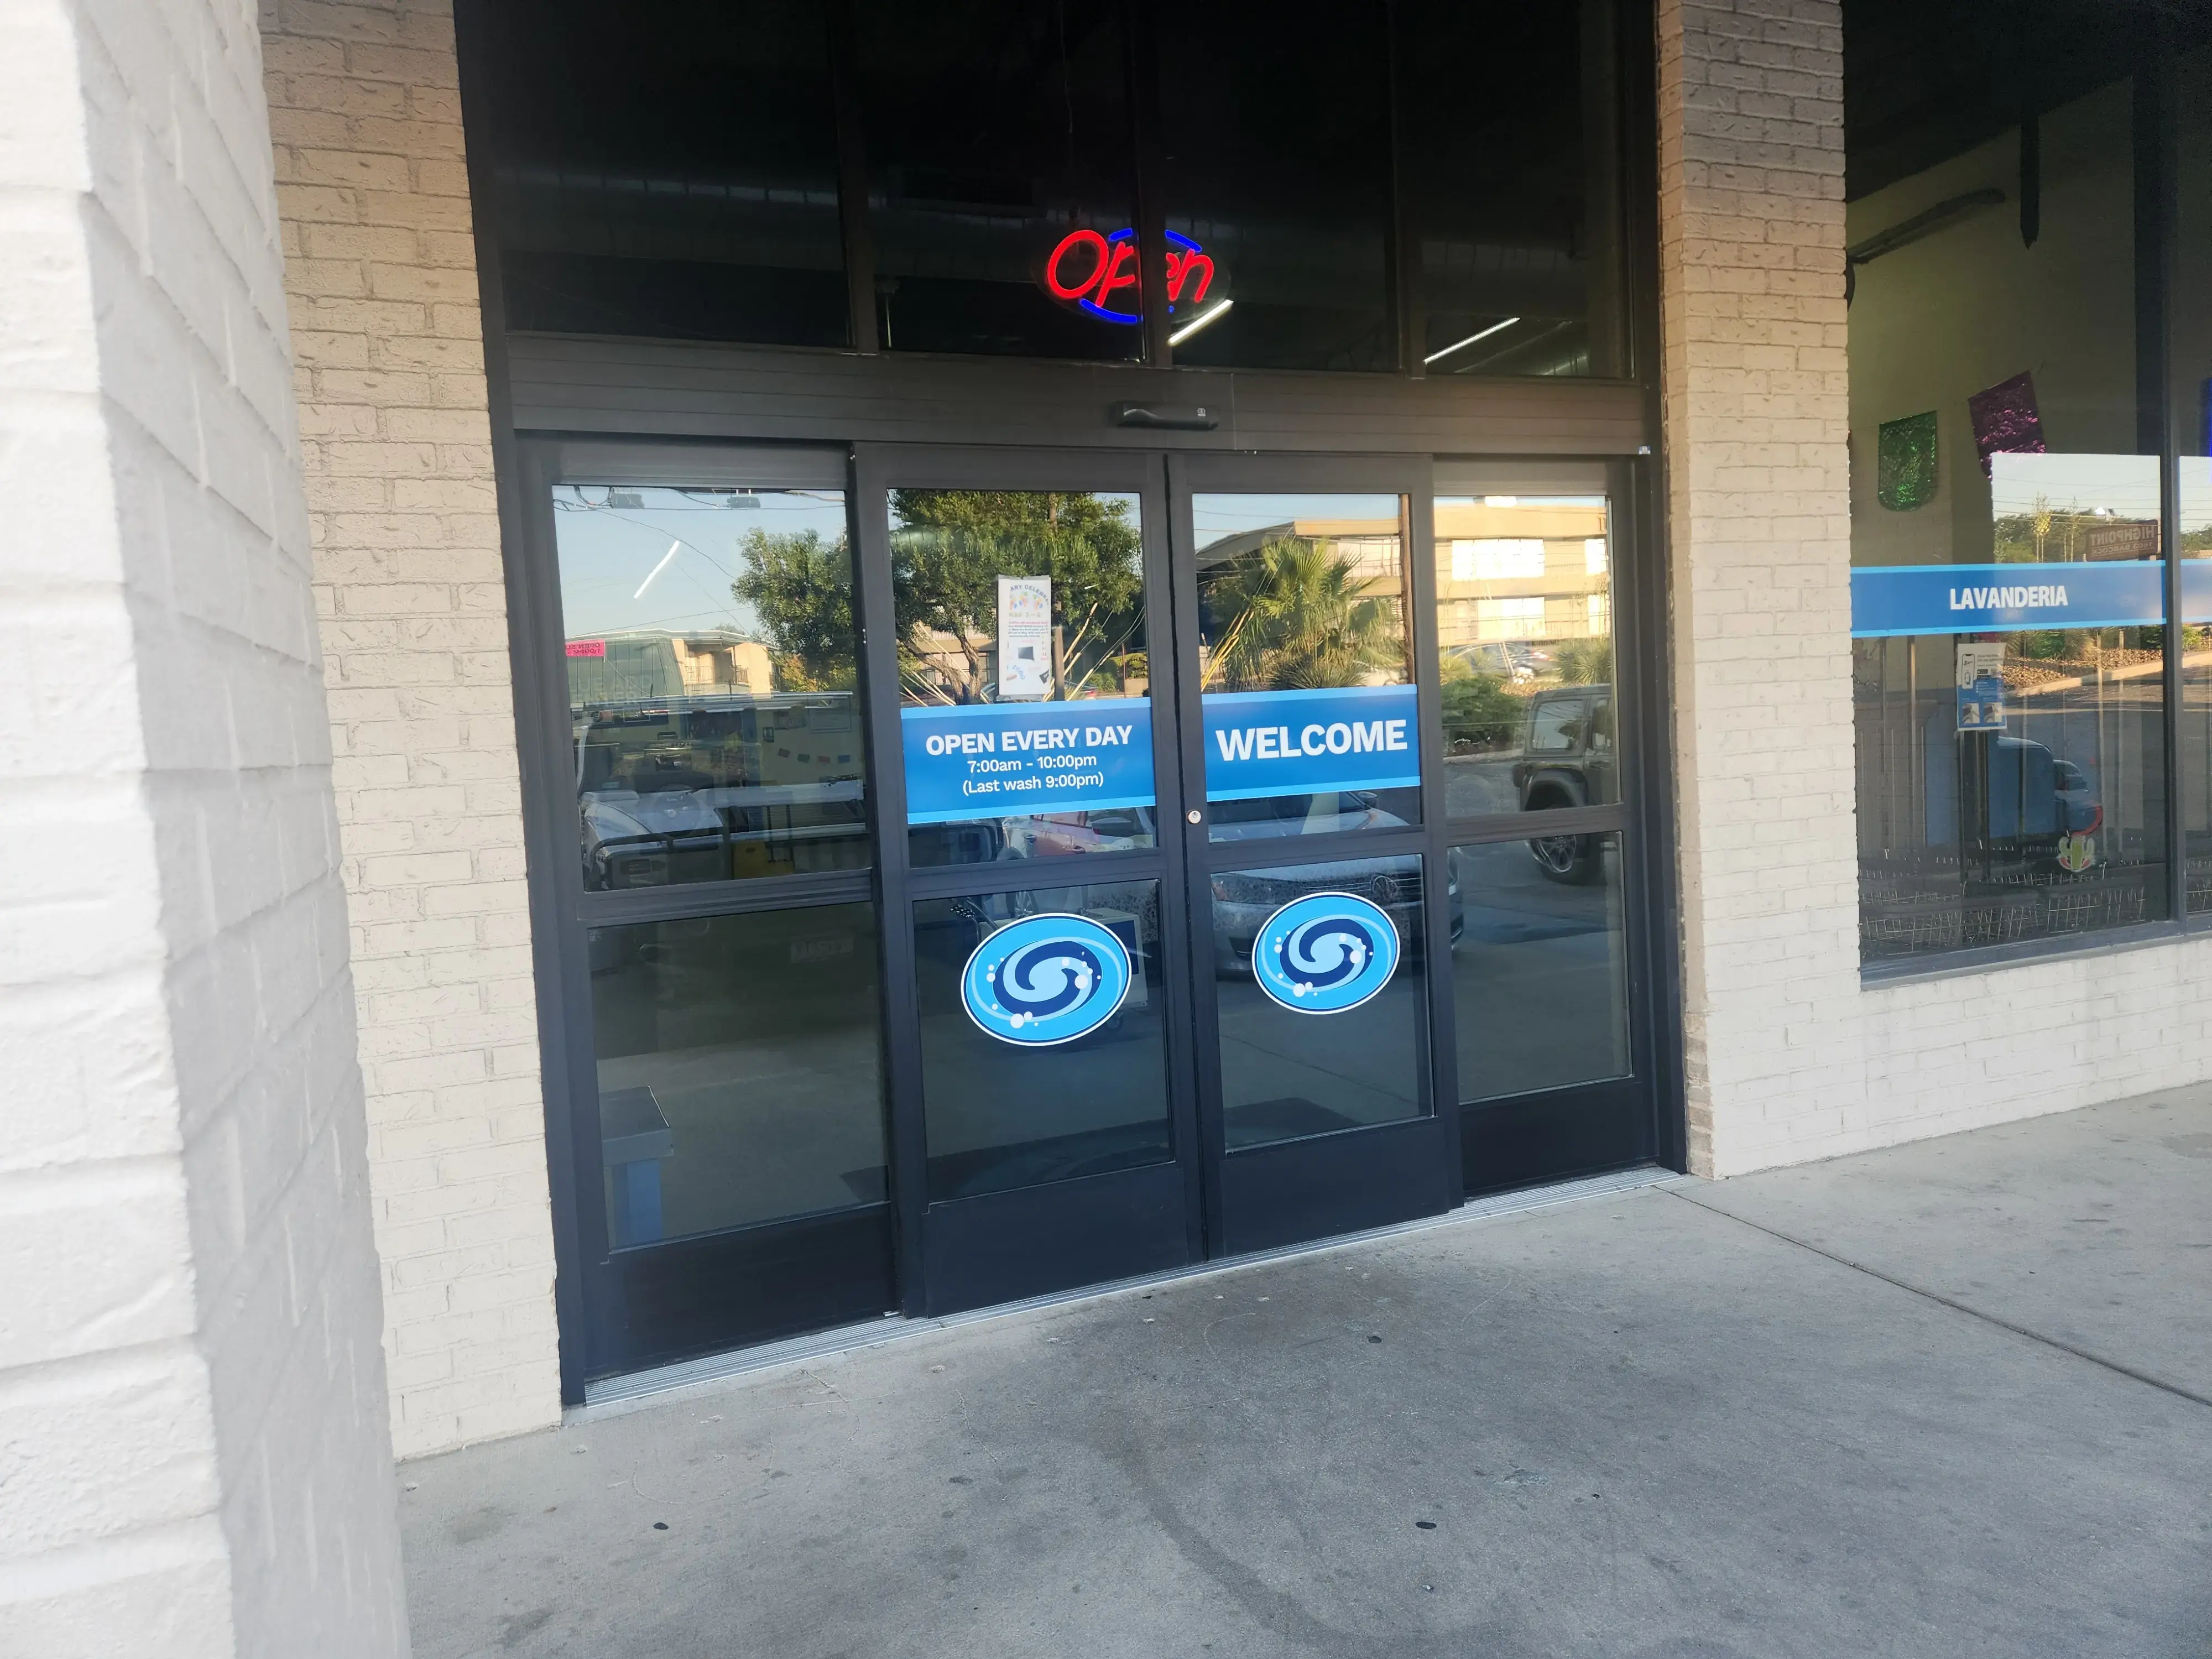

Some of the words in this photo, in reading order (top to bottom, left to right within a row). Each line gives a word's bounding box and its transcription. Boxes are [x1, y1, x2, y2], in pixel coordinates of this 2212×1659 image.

[1950, 586, 2068, 609] LAVANDERIA
[926, 733, 994, 755] OPEN
[1001, 728, 1079, 751] EVERY
[1086, 725, 1133, 747] DAY
[1215, 719, 1407, 761] WELCOME
[967, 759, 1021, 773] 7:00am
[1037, 755, 1097, 769] 10:00pm
[963, 780, 1000, 796] (Last
[1003, 776, 1041, 790] wash
[1045, 771, 1104, 791] 9:00pm)
